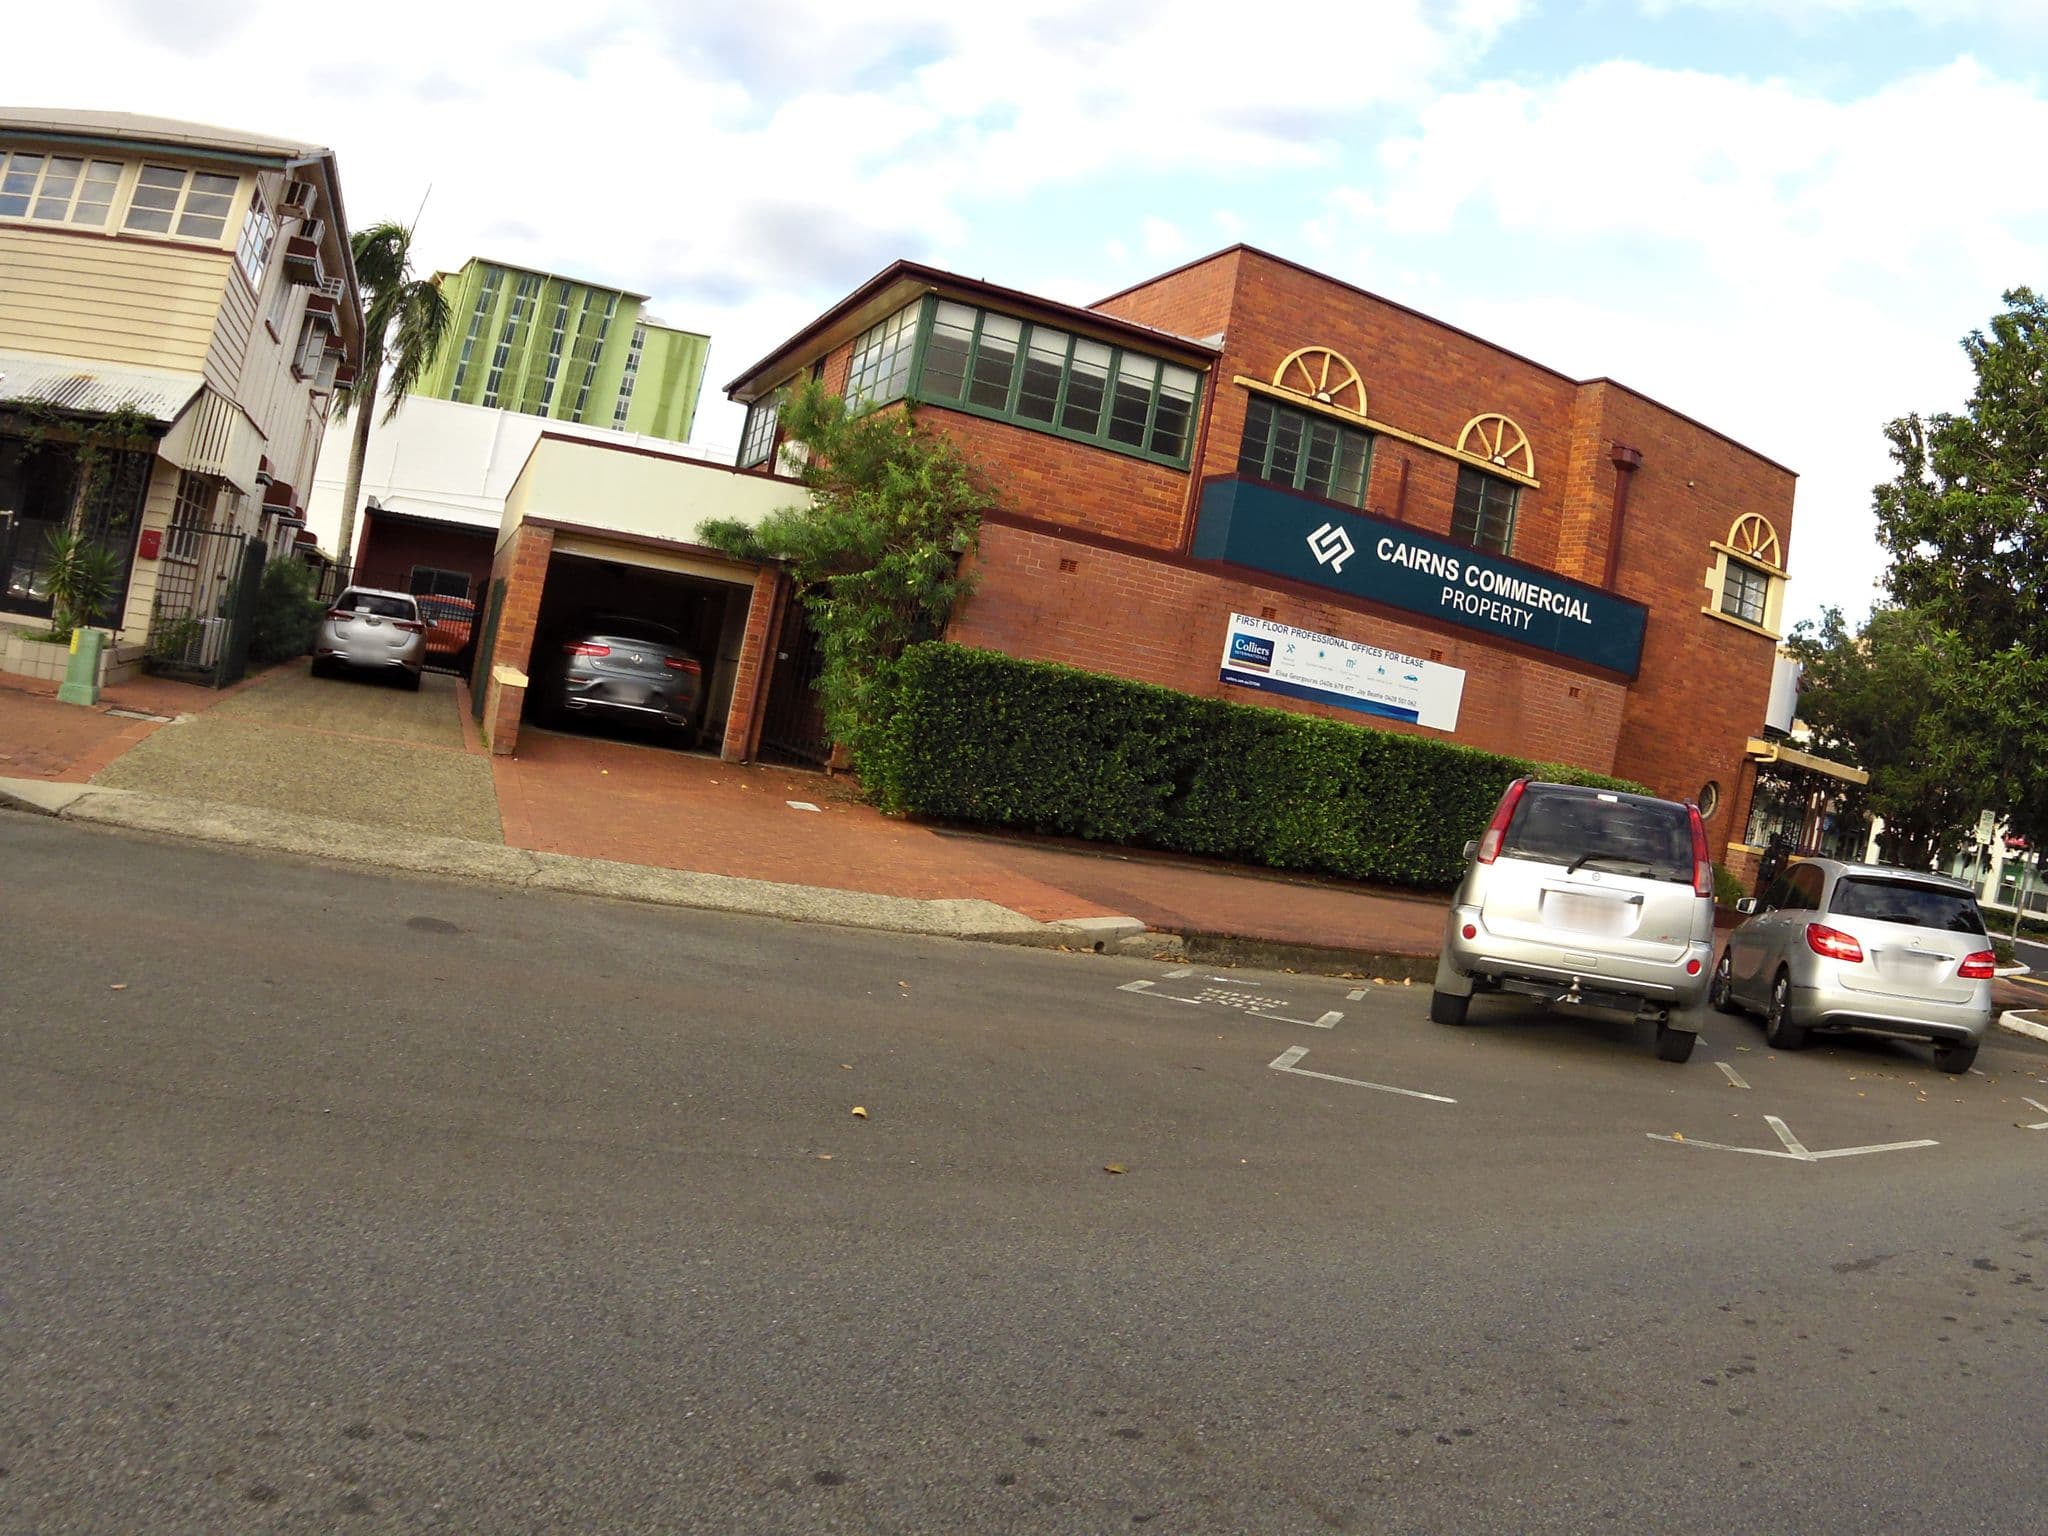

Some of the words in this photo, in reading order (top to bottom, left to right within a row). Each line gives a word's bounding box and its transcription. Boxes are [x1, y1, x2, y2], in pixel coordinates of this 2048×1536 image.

[1376, 538, 1460, 582] CAIRNS
[1464, 565, 1592, 624] COMMERCIAL
[1441, 587, 1533, 630] PROPERTY
[1234, 649, 1268, 661] INTERNATIONAL
[1235, 638, 1270, 657] Colliers
[1236, 615, 1260, 628] FIRST
[1262, 621, 1289, 635] FLOOR
[1290, 628, 1349, 650] PROFESSIONAL
[1351, 643, 1383, 658] OFFICES
[1384, 651, 1399, 662] FOR
[1400, 656, 1424, 669] LEASE
